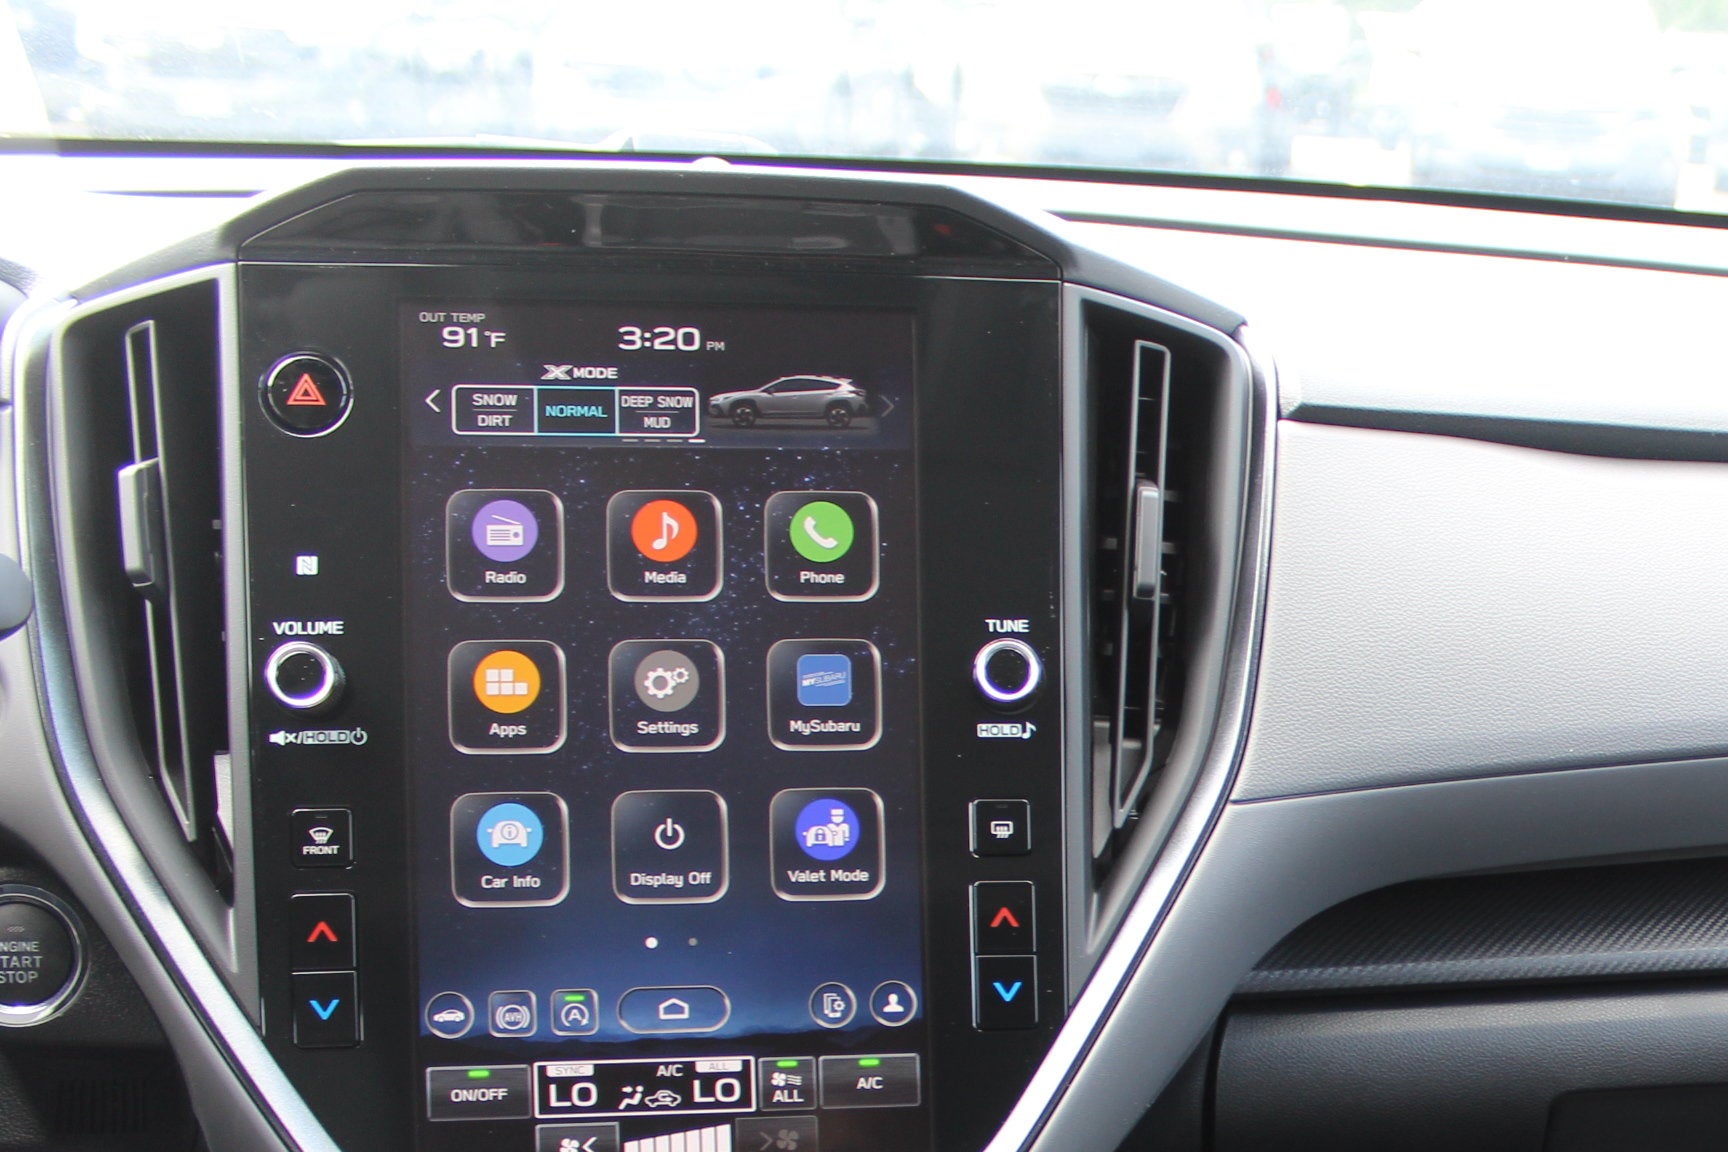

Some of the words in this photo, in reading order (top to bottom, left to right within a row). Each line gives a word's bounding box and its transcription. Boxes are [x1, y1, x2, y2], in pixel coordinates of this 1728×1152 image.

[418, 311, 446, 323] OUT
[450, 311, 486, 324] TEMP
[617, 326, 701, 351] 3:20
[706, 341, 726, 351] PM
[472, 393, 518, 407] SNOW
[620, 396, 654, 408] DEEP
[657, 396, 694, 408] SNOW
[545, 405, 608, 418] NORMAL
[477, 414, 514, 427] DIRT
[642, 417, 671, 429] MUD
[485, 571, 527, 585] Radio
[644, 570, 687, 584] Media
[800, 570, 845, 584] Phone
[272, 620, 345, 635] VOLUME
[984, 619, 1030, 633] TUNE
[489, 721, 527, 738] Apps
[637, 721, 699, 736] Settings
[789, 719, 860, 735] MySubaru
[978, 724, 1021, 736] HOLD
[302, 845, 340, 855] FRONT
[480, 875, 508, 889] Car
[512, 874, 541, 889] Info
[629, 871, 684, 888] Display
[688, 871, 712, 885] Off
[787, 869, 827, 883] Valet
[830, 869, 869, 882] Mode
[0, 955, 44, 968] TART
[656, 1064, 684, 1077] A/C
[692, 1078, 742, 1103] LO
[856, 1077, 884, 1090] A/C
[450, 1088, 509, 1102] ON/OFF
[548, 1081, 599, 1108] LO
[772, 1089, 805, 1103] ALL
